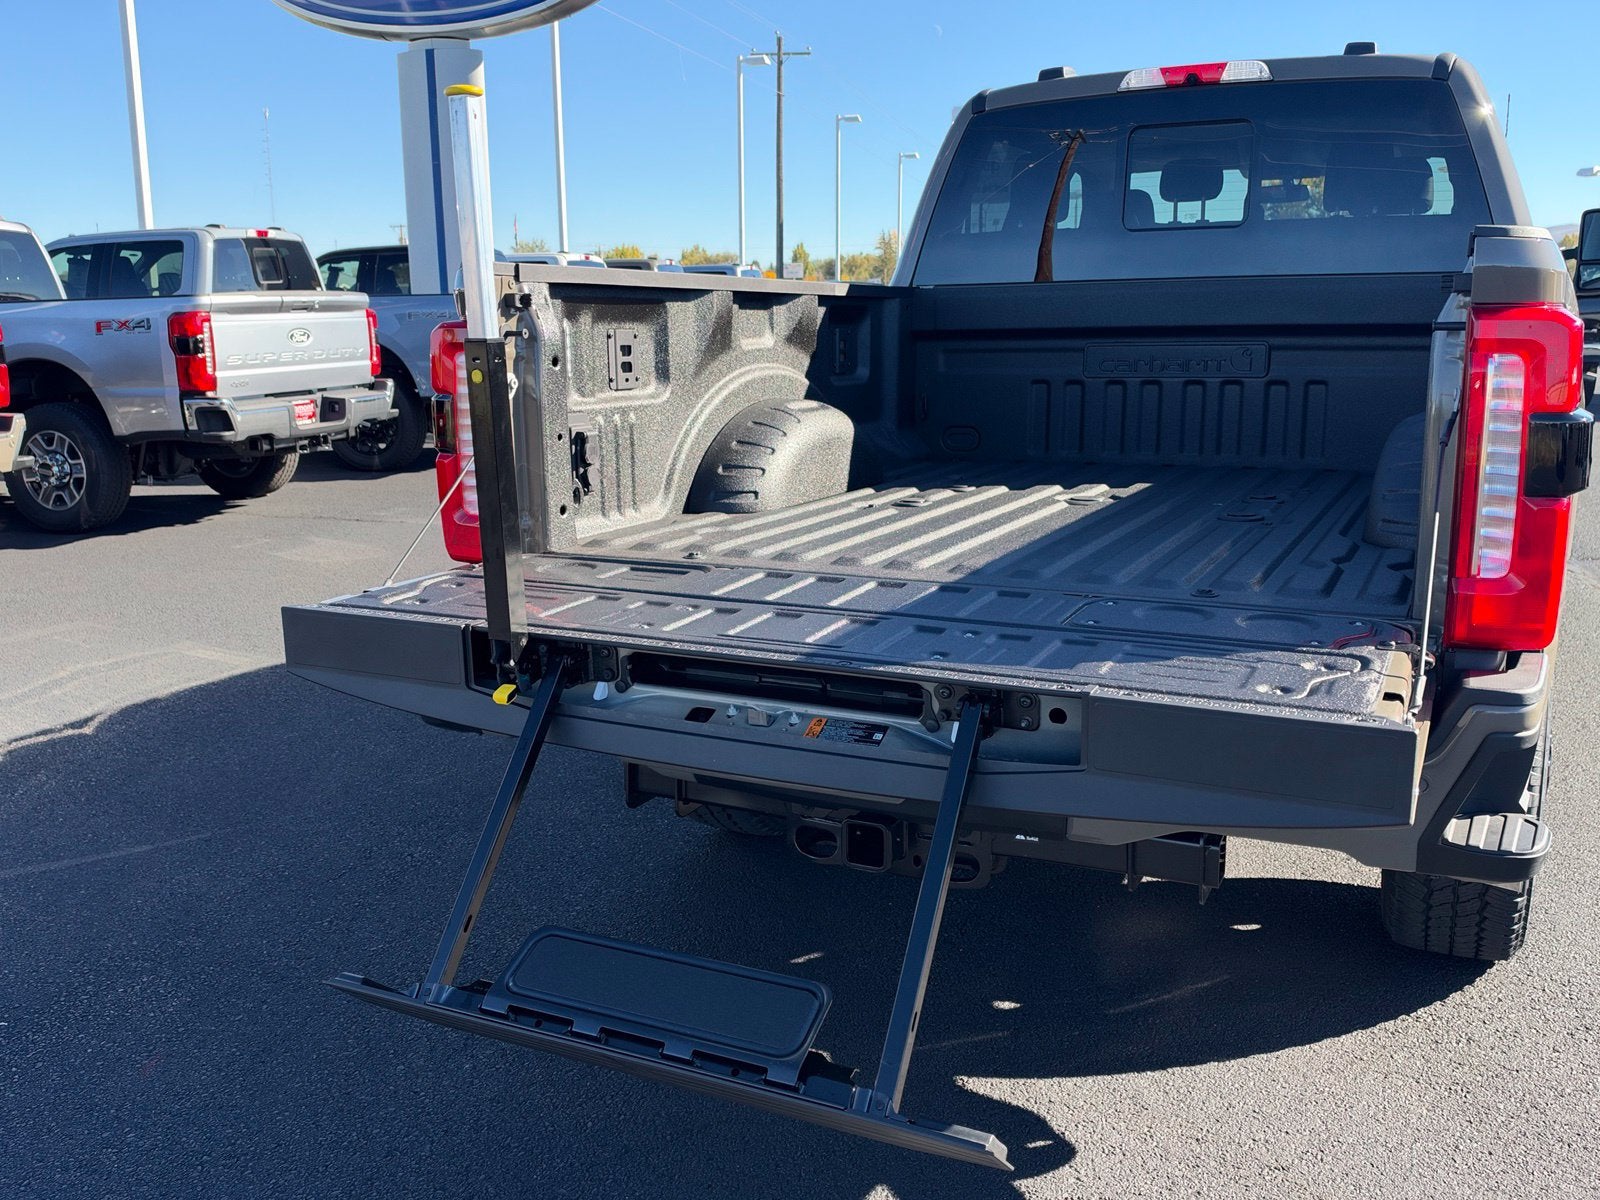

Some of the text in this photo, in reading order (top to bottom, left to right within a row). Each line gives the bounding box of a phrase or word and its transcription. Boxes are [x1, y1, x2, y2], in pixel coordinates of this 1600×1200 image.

[95, 318, 151, 336] FX4
[226, 347, 364, 366] SUPER DUTY
[1100, 355, 1226, 373] carhartt
